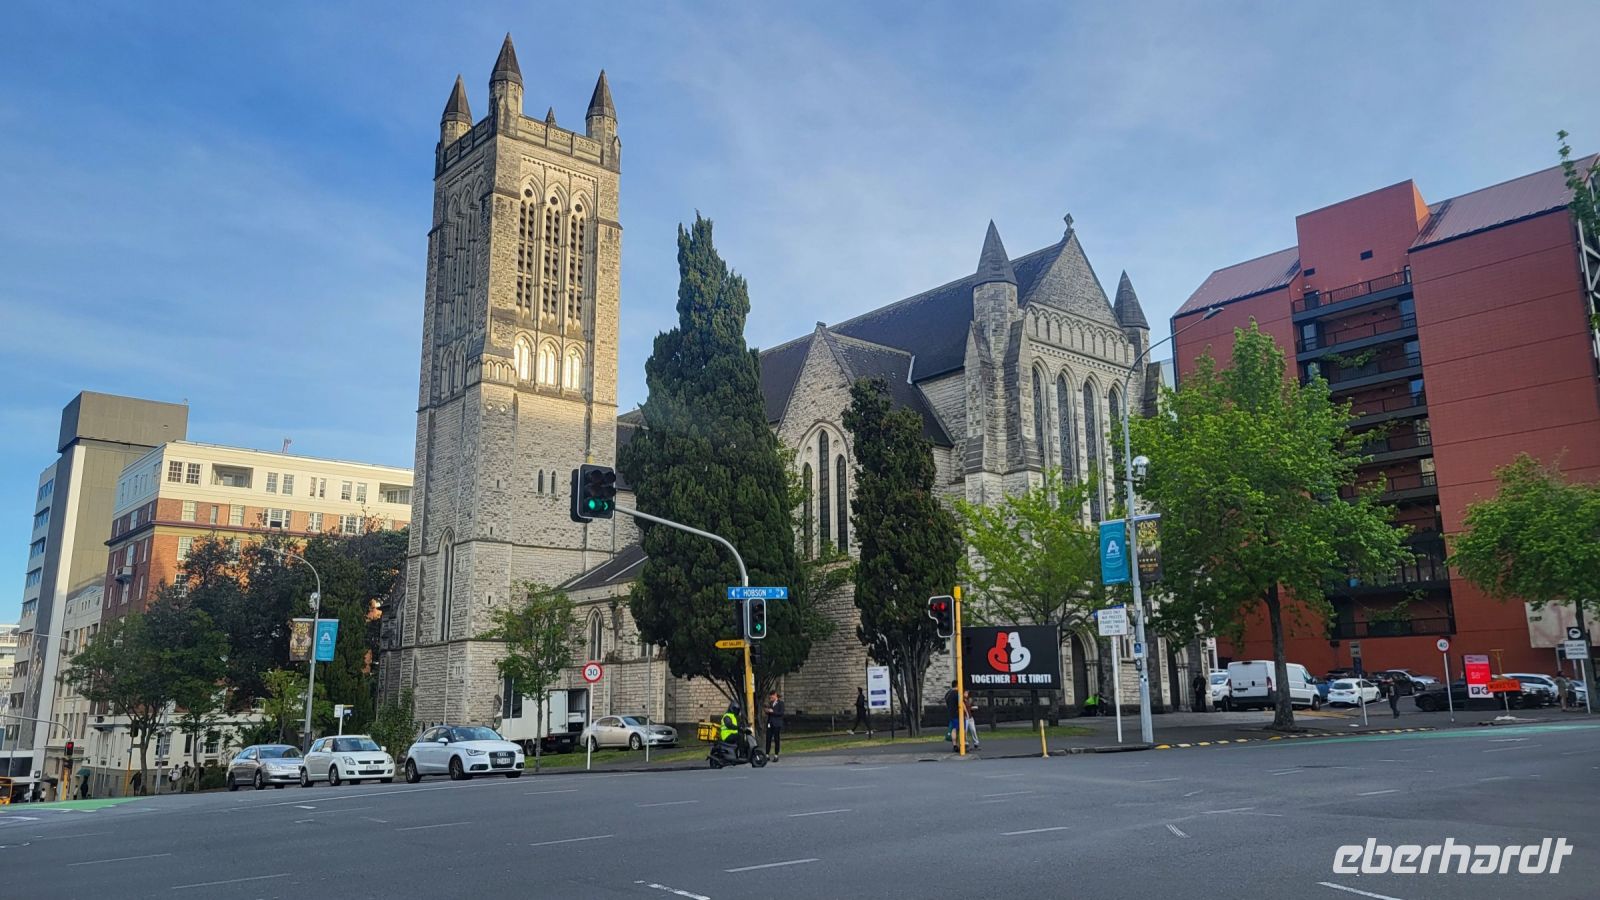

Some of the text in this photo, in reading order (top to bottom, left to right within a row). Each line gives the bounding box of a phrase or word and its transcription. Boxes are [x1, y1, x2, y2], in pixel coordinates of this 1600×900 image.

[743, 588, 767, 598] HOBSON
[587, 668, 598, 677] 30
[971, 674, 1010, 684] TOGETHER
[1017, 674, 1027, 684] TE
[1028, 674, 1052, 684] TIRITI
